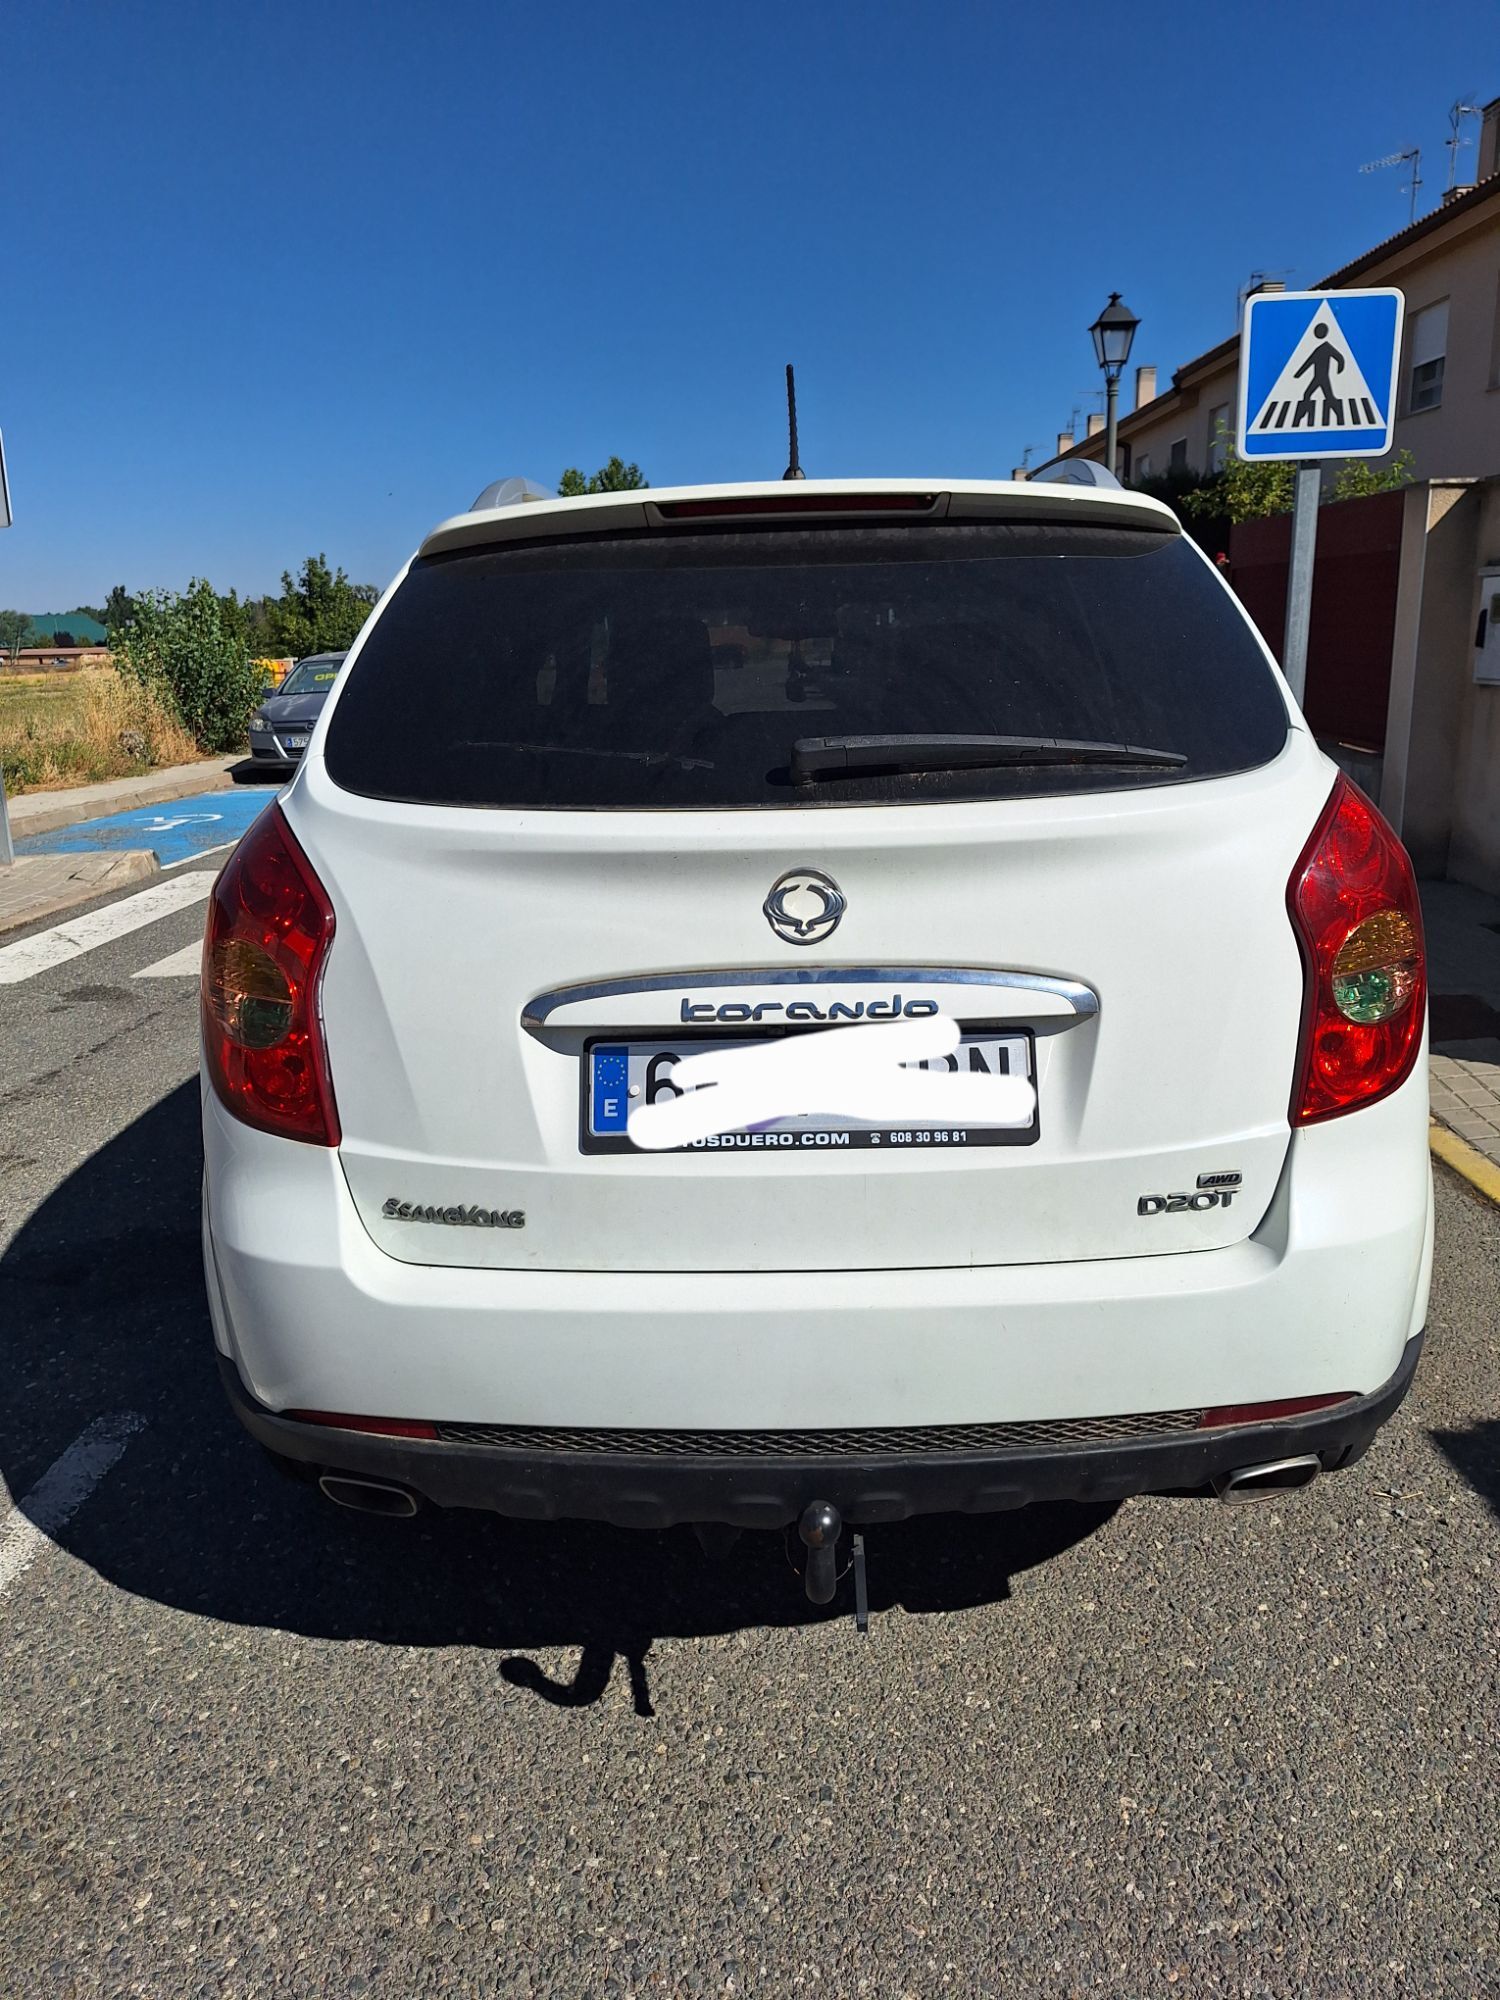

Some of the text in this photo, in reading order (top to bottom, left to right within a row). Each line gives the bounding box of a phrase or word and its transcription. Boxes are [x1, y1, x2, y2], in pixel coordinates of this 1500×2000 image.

[681, 994, 939, 1022] korando
[604, 1099, 618, 1117] E
[681, 1131, 967, 1148] OSDUERO.COM 608 30 96 81
[1203, 1173, 1240, 1185] AWD
[1137, 1189, 1241, 1216] D20T
